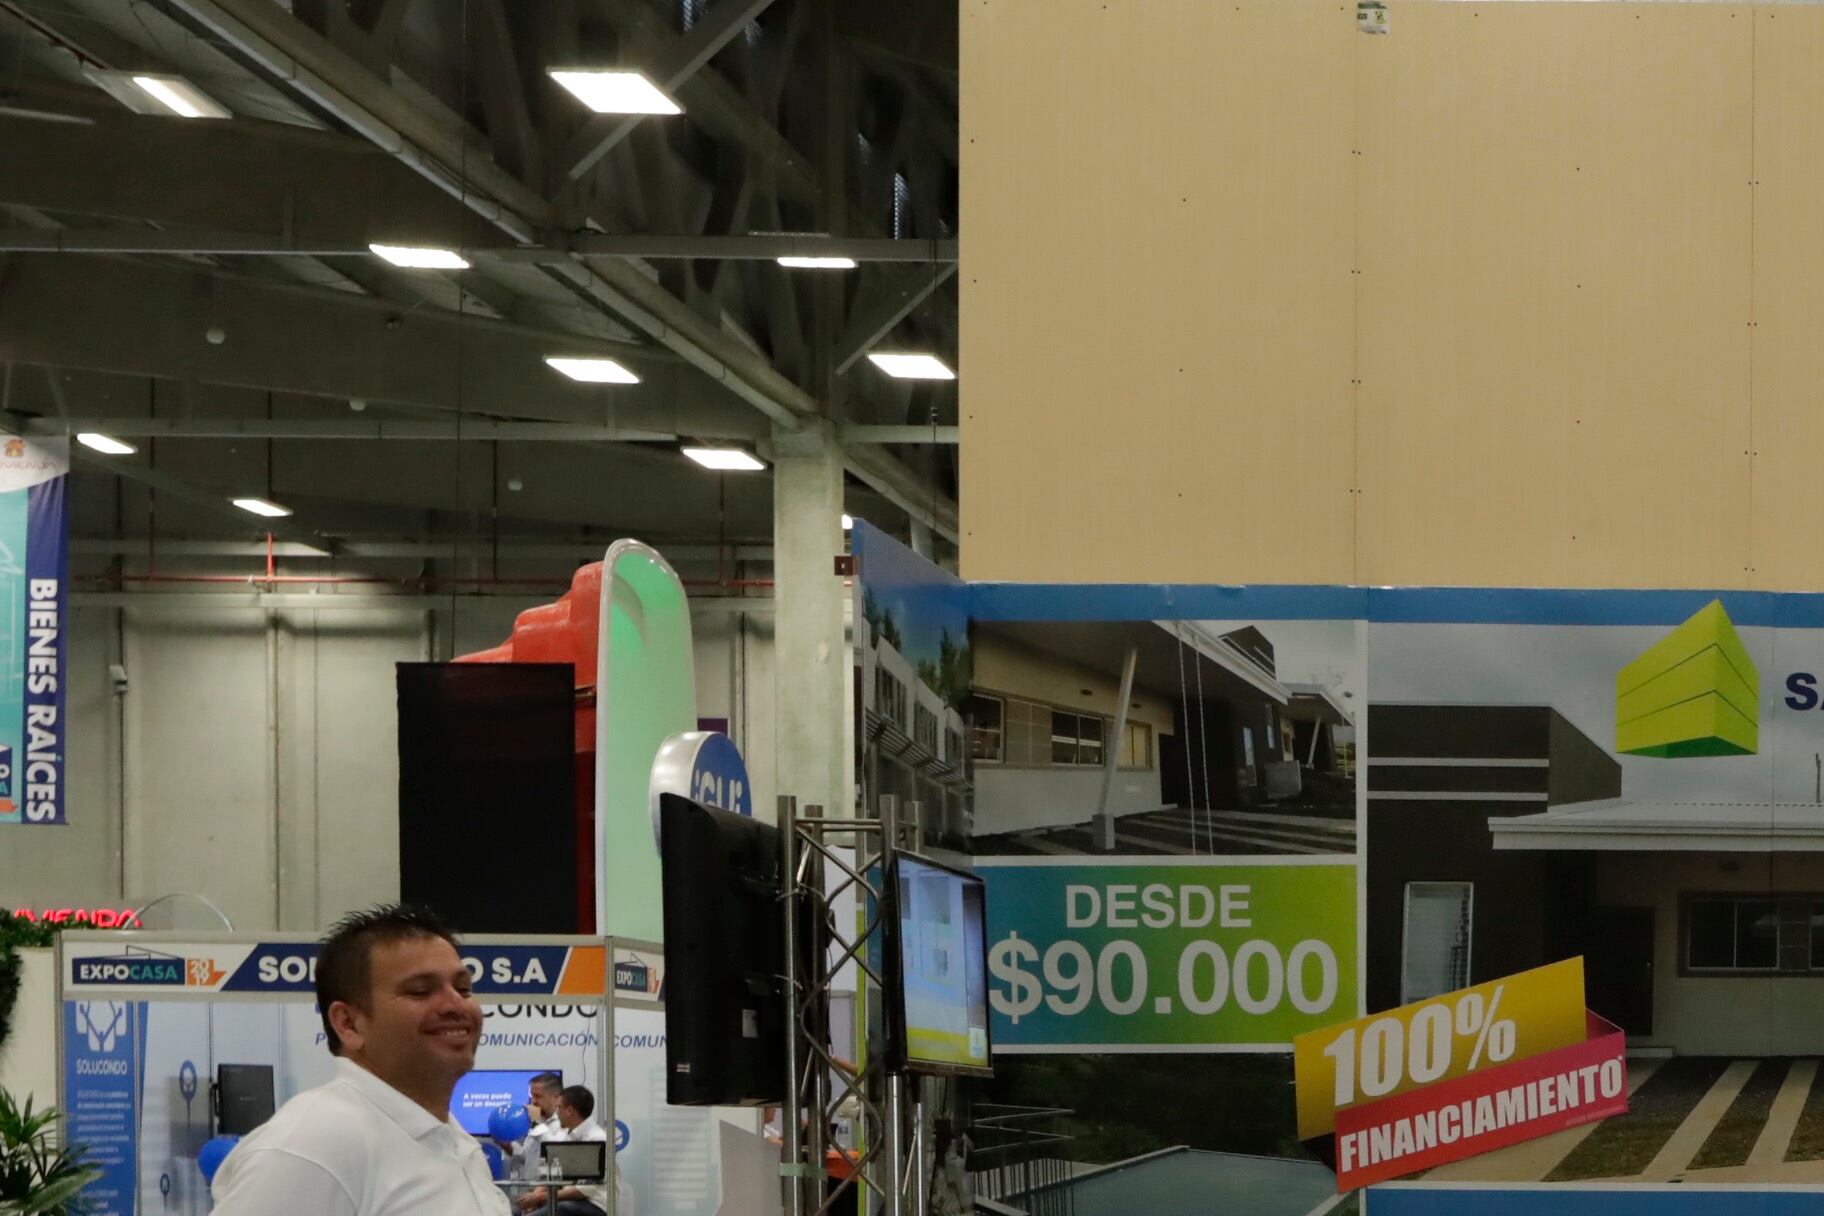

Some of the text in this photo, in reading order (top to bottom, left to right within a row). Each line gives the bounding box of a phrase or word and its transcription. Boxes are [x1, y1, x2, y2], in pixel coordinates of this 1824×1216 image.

[28, 578, 58, 694] BIENES
[1065, 883, 1252, 929] DESDE
[79, 963, 178, 980] EXPOCASA
[491, 957, 547, 984] S.A
[987, 930, 1339, 1025] $90.000
[1324, 984, 1516, 1107] 100%
